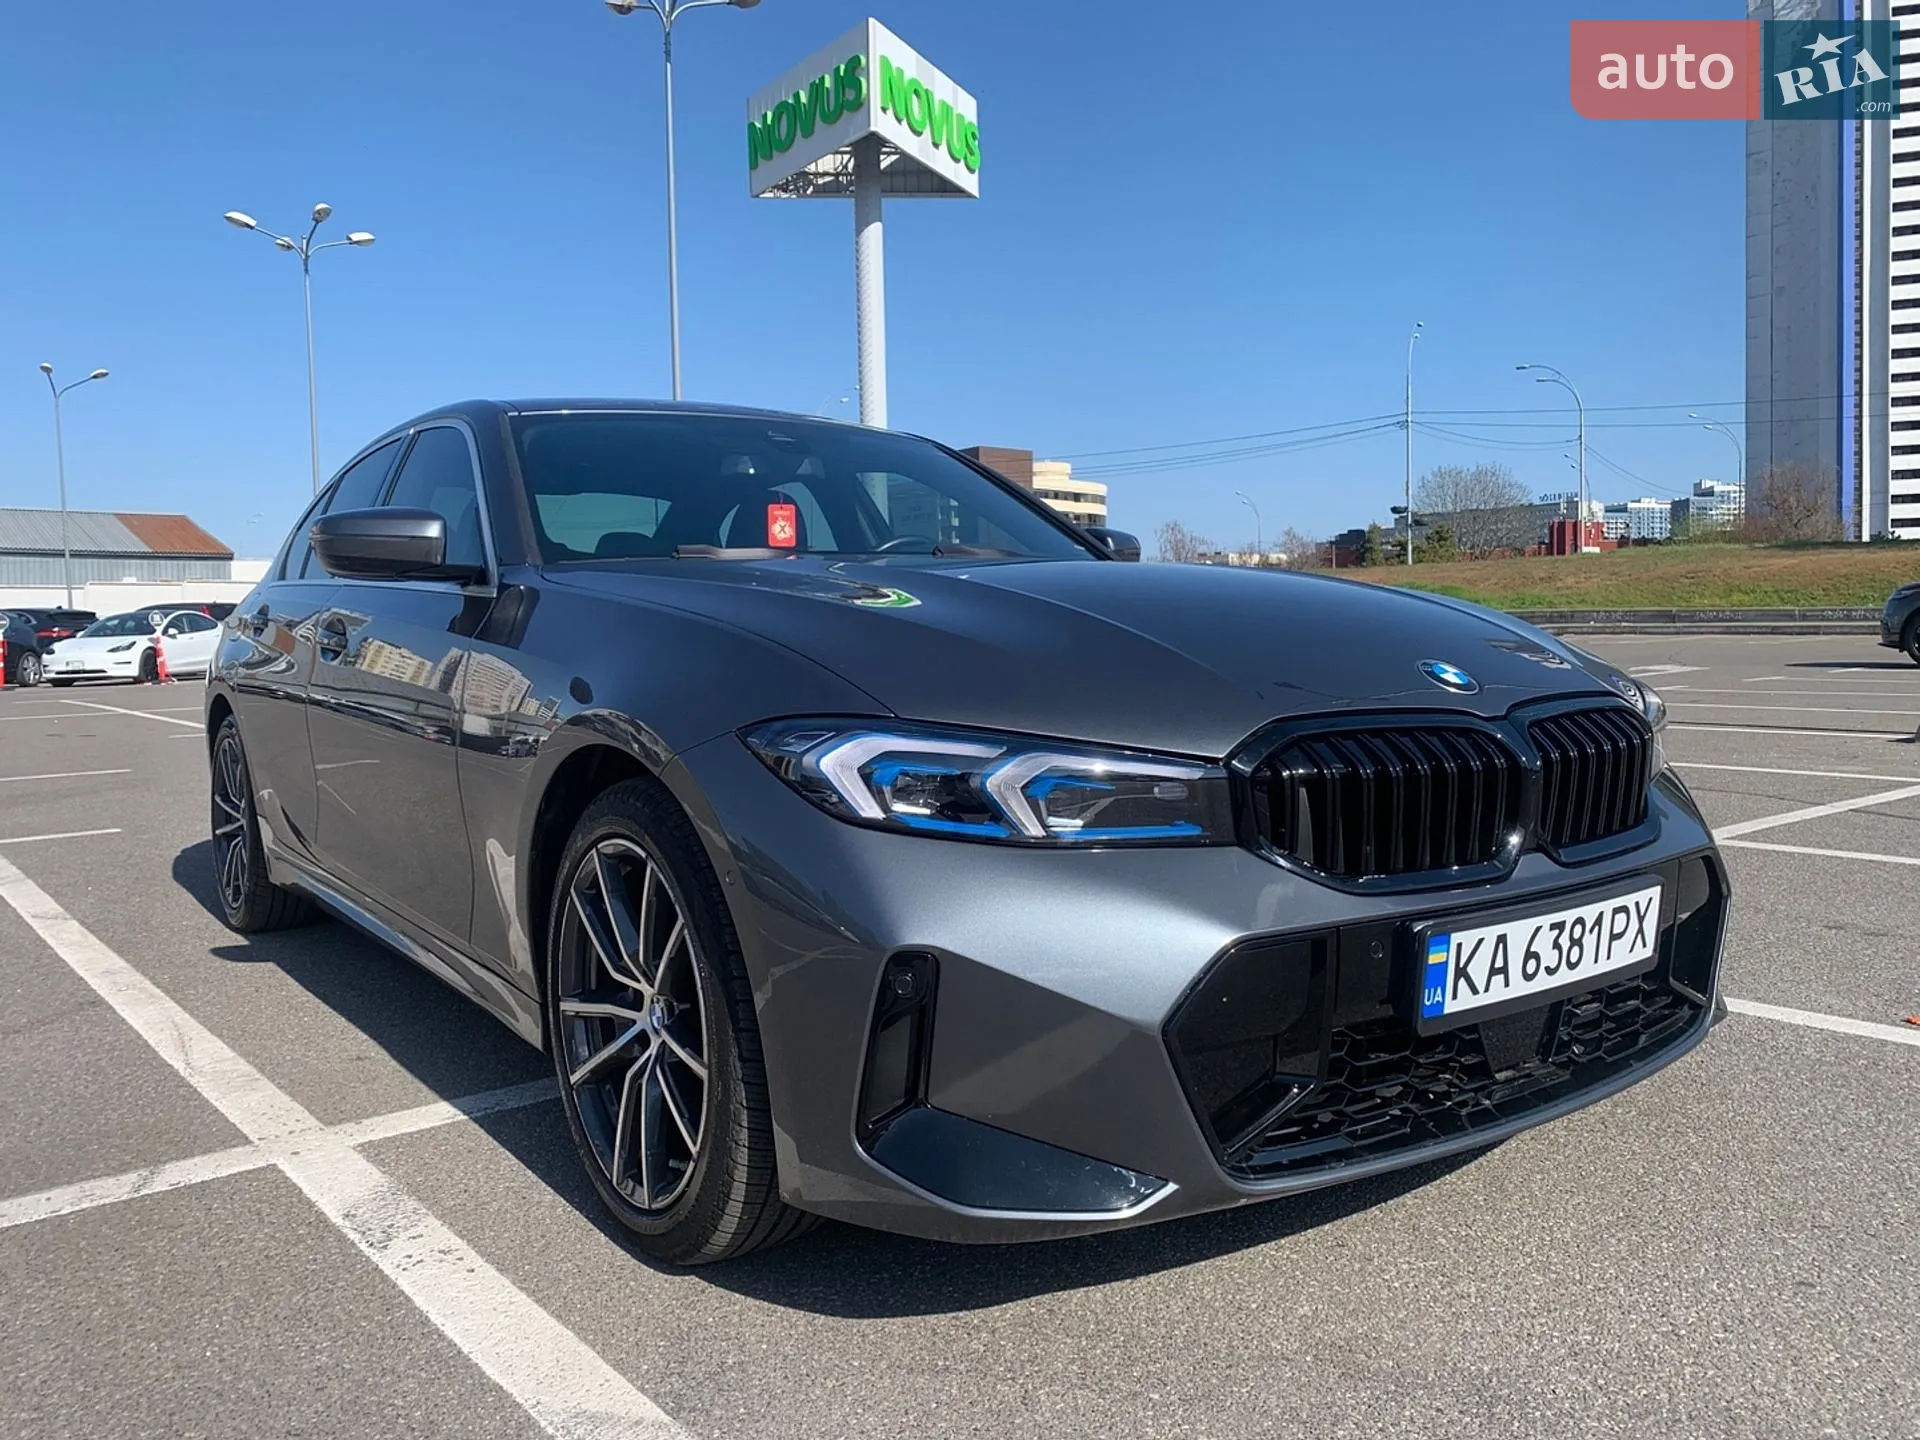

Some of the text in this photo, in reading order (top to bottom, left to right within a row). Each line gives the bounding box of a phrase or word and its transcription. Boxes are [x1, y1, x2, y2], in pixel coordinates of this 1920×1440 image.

[748, 55, 866, 170] NOVUS
[880, 55, 981, 173] NOVUS
[1424, 988, 1443, 1006] UA
[1452, 933, 1510, 1001] KA
